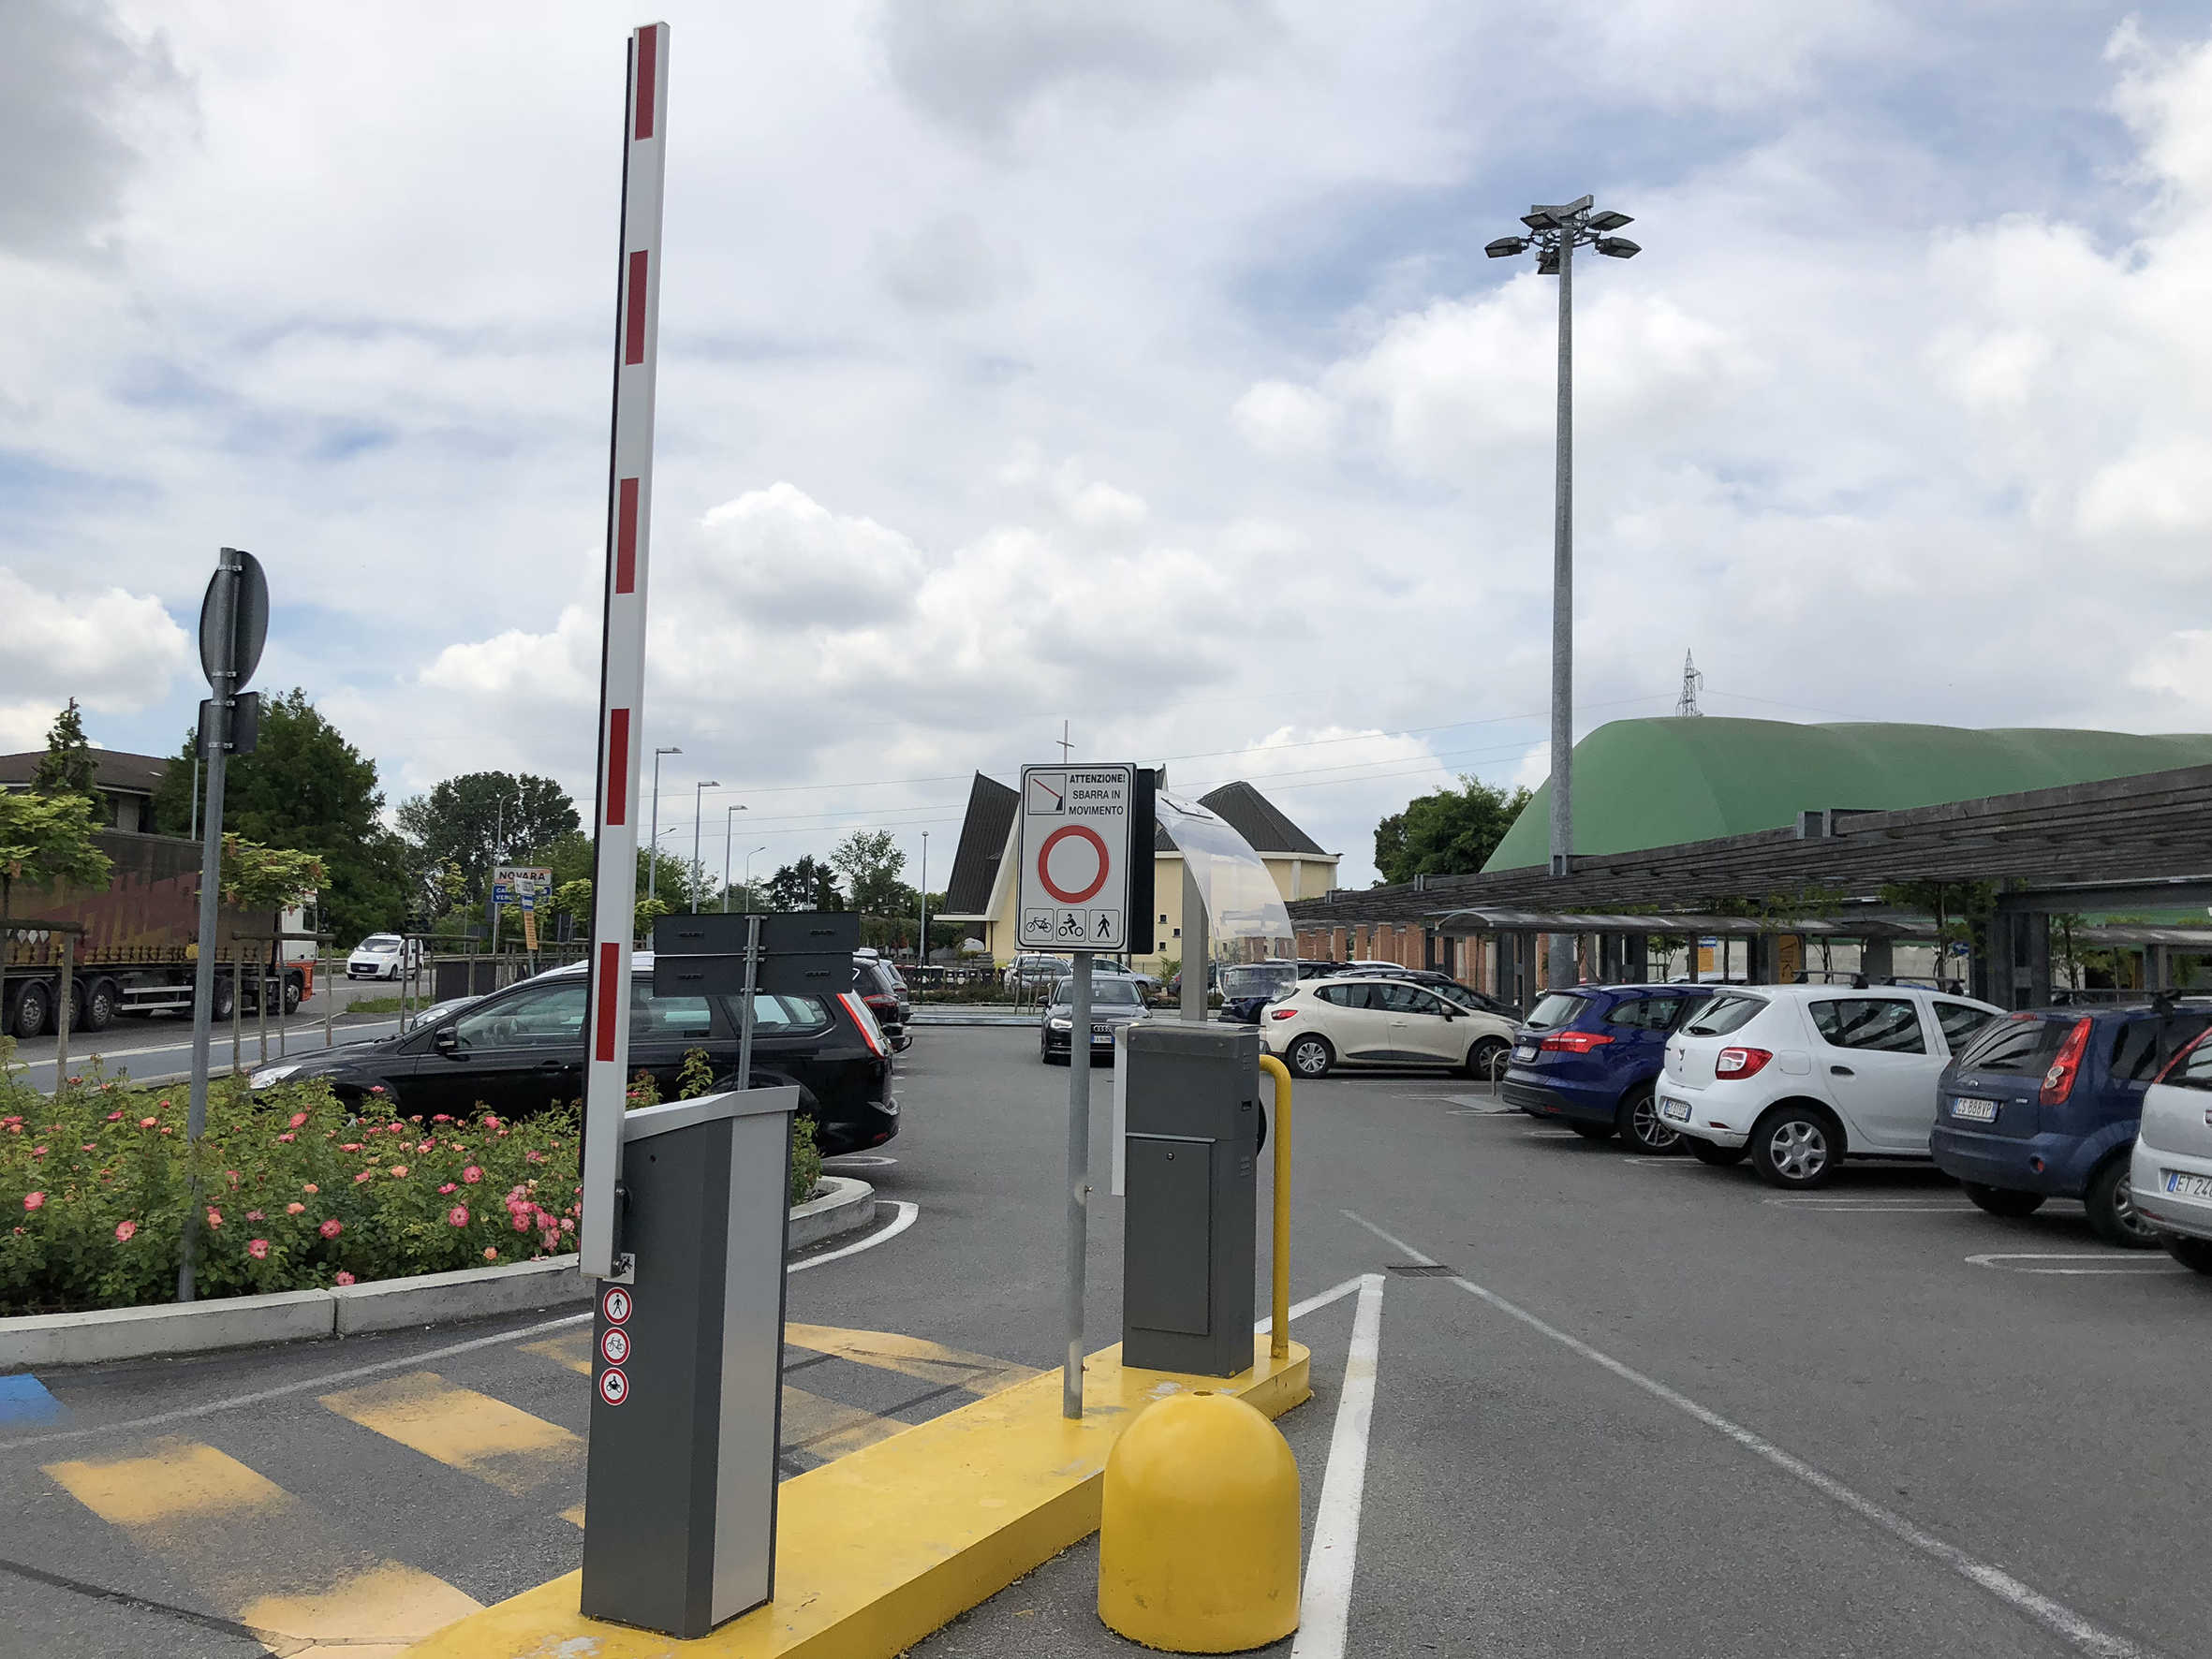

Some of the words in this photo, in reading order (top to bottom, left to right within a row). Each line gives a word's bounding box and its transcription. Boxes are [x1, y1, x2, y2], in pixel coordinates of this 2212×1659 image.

[1069, 773, 1126, 784] ATTENZIONE!
[1072, 789, 1109, 800] SBARRA
[1111, 789, 1121, 800] IN
[1069, 805, 1124, 815] MOVIMENTO
[499, 871, 546, 881] NOVARA
